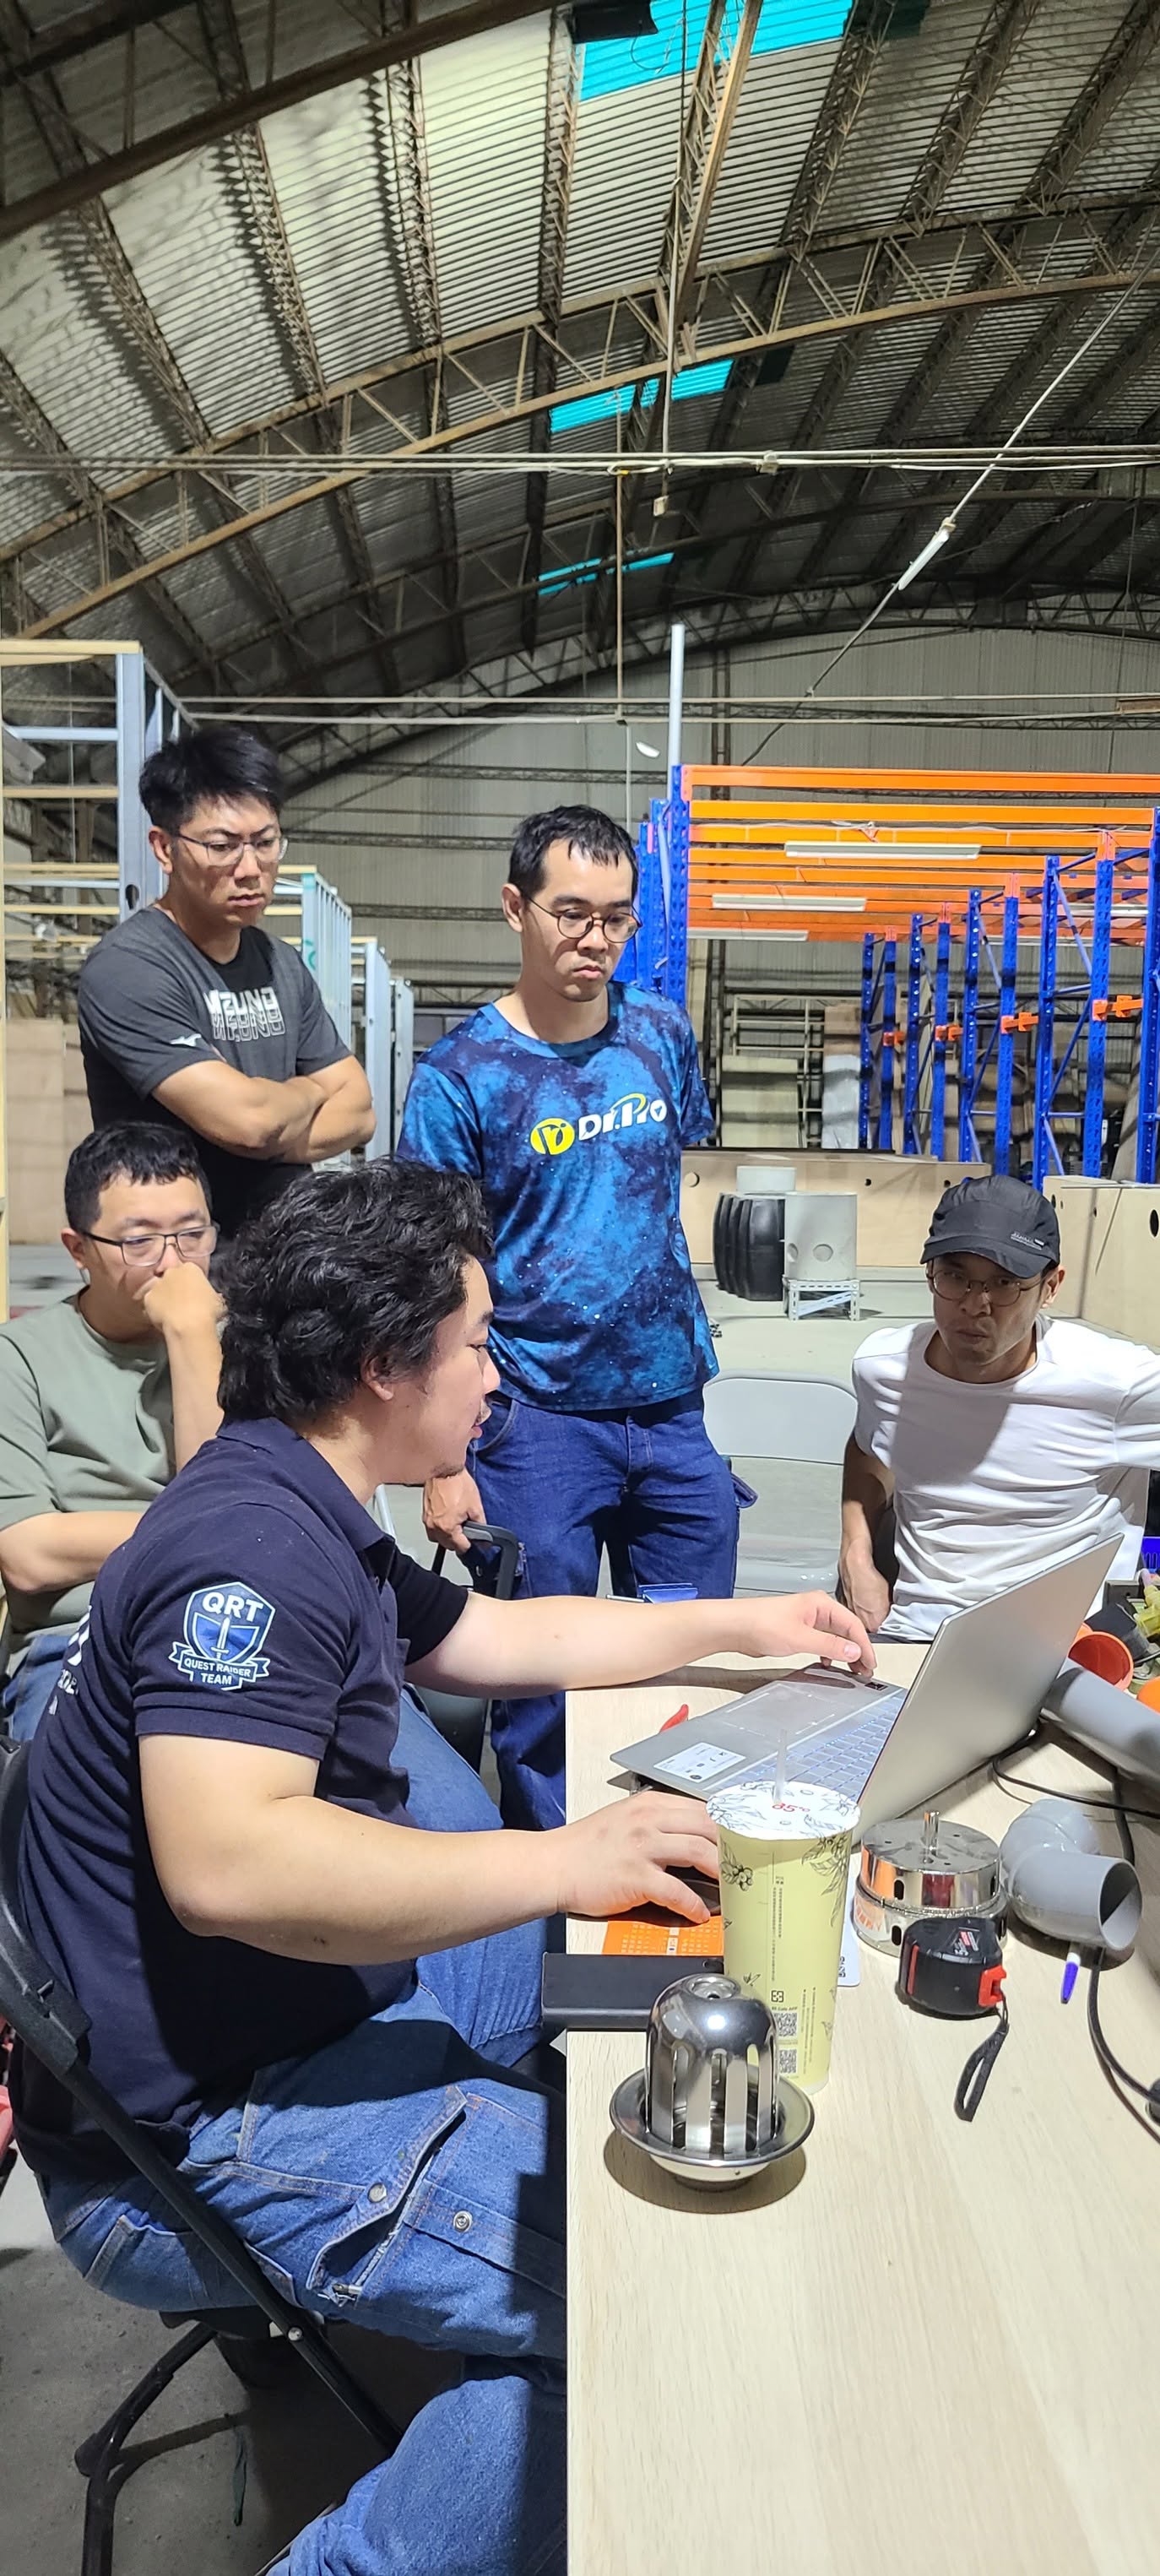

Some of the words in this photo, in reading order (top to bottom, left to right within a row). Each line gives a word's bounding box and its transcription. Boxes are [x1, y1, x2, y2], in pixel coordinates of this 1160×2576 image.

[202, 1592, 264, 1622] QRT
[183, 1658, 215, 1672] QUEST
[216, 1662, 252, 1678] RAIDER
[200, 1673, 232, 1685] TEAM
